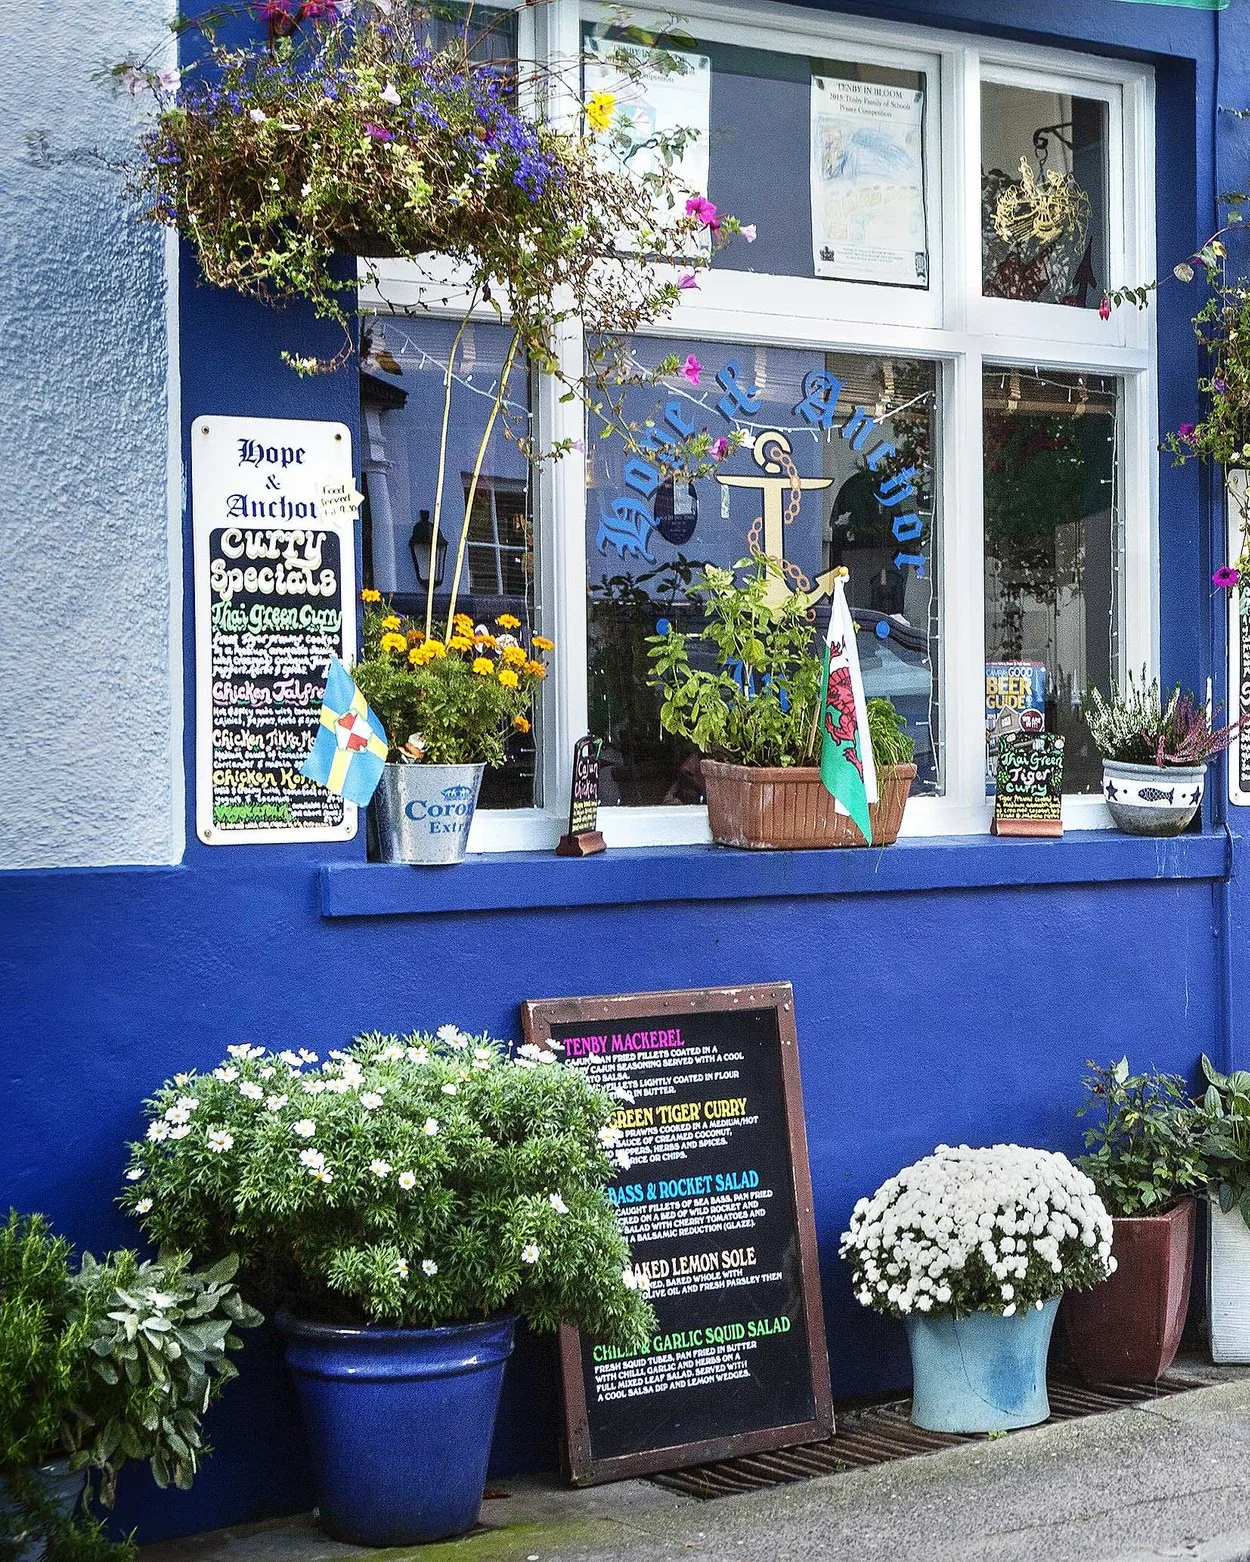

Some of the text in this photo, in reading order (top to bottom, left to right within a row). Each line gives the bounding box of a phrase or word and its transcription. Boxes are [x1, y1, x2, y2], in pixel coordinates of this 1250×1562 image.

[864, 86, 872, 95] IN
[237, 438, 306, 469] Hope
[265, 474, 281, 490] &
[221, 528, 327, 571] Curry
[211, 558, 337, 601] Specials
[211, 602, 248, 632] Thai
[300, 604, 342, 632] Curry
[1009, 667, 1033, 677] GOOD
[213, 679, 324, 706] Chicken Jalfre
[986, 677, 1032, 695] BEER
[986, 695, 1026, 709] GUIDE
[213, 727, 300, 750] Chicken Tikka
[1001, 751, 1063, 770] Thai Green
[213, 769, 277, 787] Chicken
[405, 800, 475, 820] Coro
[429, 821, 466, 834] Extr
[563, 1029, 684, 1056] TENBY MACKEREL
[617, 1057, 693, 1072] SEASONING SERVED
[609, 1108, 653, 1129] GREEN
[704, 1098, 748, 1120] CURRY
[647, 1182, 657, 1200] &
[659, 1175, 713, 1199] ROCKET
[715, 1170, 759, 1192] SALAD
[671, 1251, 719, 1276] LEMON
[721, 1247, 757, 1269] SOLE
[653, 1330, 703, 1353] GARLIC
[705, 1323, 745, 1346] SQUID
[747, 1316, 791, 1338] SALAD
[605, 1391, 627, 1401] COOL
[687, 1376, 715, 1388] LEMON
